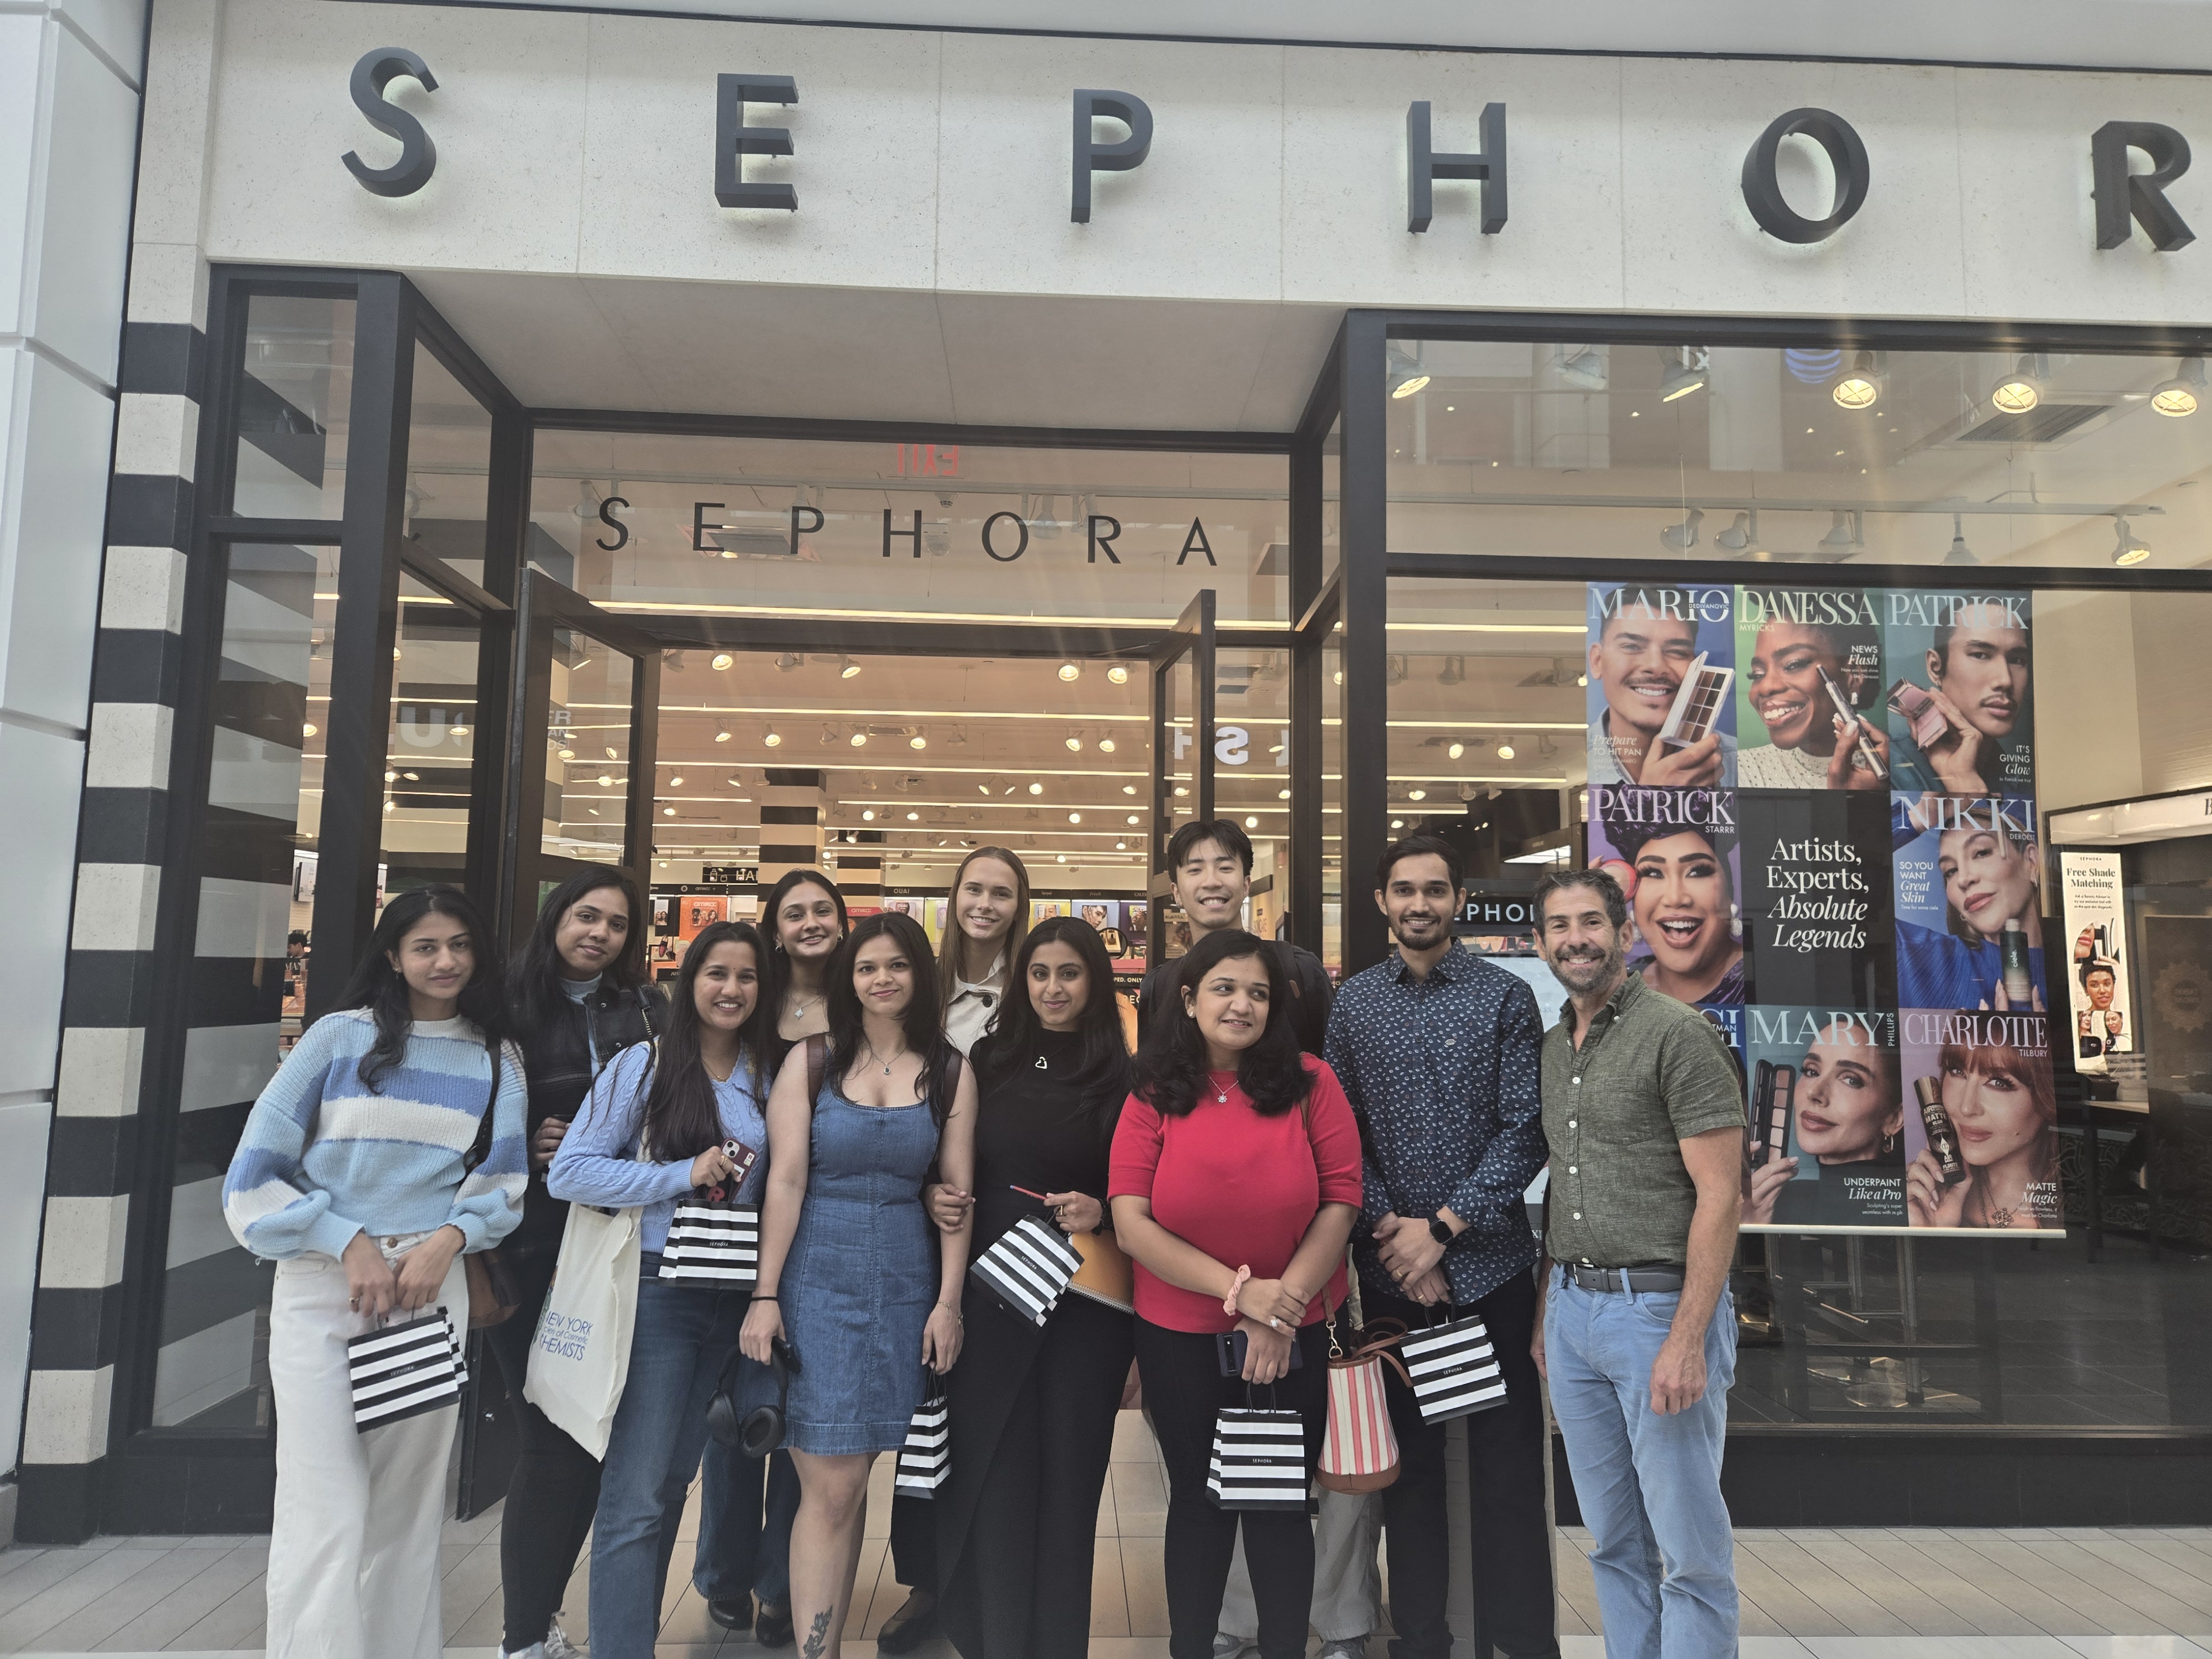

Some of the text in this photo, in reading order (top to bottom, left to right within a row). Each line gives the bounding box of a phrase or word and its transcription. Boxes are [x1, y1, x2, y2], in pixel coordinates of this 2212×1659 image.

[341, 46, 2197, 252] SEPHOR
[595, 496, 1217, 566] SEPHORA
[1589, 588, 1730, 622] MARIO
[1739, 591, 1880, 625] DANESSA
[1888, 594, 2029, 630] PATRICK
[1851, 645, 1879, 654] NEWS
[1848, 654, 1878, 666] Flash
[1593, 734, 1637, 747] Prepare
[1593, 748, 1641, 757] TO HIT PAN
[2016, 745, 2030, 754] IT'S
[1999, 754, 2030, 763] GIVING
[2005, 763, 2031, 775] Glow
[1591, 789, 1735, 825] PATRICK
[1897, 796, 2034, 833] NIKKI
[1705, 826, 1735, 834] STARRR
[1770, 837, 1862, 865] Artists,
[1900, 862, 1933, 870] SO YOU
[2067, 868, 2116, 877] Free Shade
[1766, 865, 1869, 894] Experts,
[1900, 872, 1927, 880] WANT
[1900, 880, 1931, 892] Great
[2070, 878, 2114, 890] Matching
[1900, 891, 1925, 904] Skin
[1767, 894, 1868, 921] Absolute
[1772, 923, 1866, 953] Legends
[1750, 1010, 1885, 1046] MARY
[1886, 1013, 1895, 1047] PHILLIPS
[1905, 1013, 2047, 1050] CHARLOTTE
[1925, 1113, 1947, 1124] MATTE
[1844, 1177, 1901, 1187] UNDERPAINT
[2026, 1182, 2057, 1192] MATTE
[1849, 1187, 1902, 1201] Like a Pro
[2021, 1192, 2058, 1206] Magic
[1021, 1255, 1037, 1270] SEPHORA
[567, 1317, 594, 1337] YORK
[564, 1331, 588, 1345] Cosmetic
[390, 1365, 414, 1376] SEPHORA
[1443, 1366, 1463, 1375] SEPHORA
